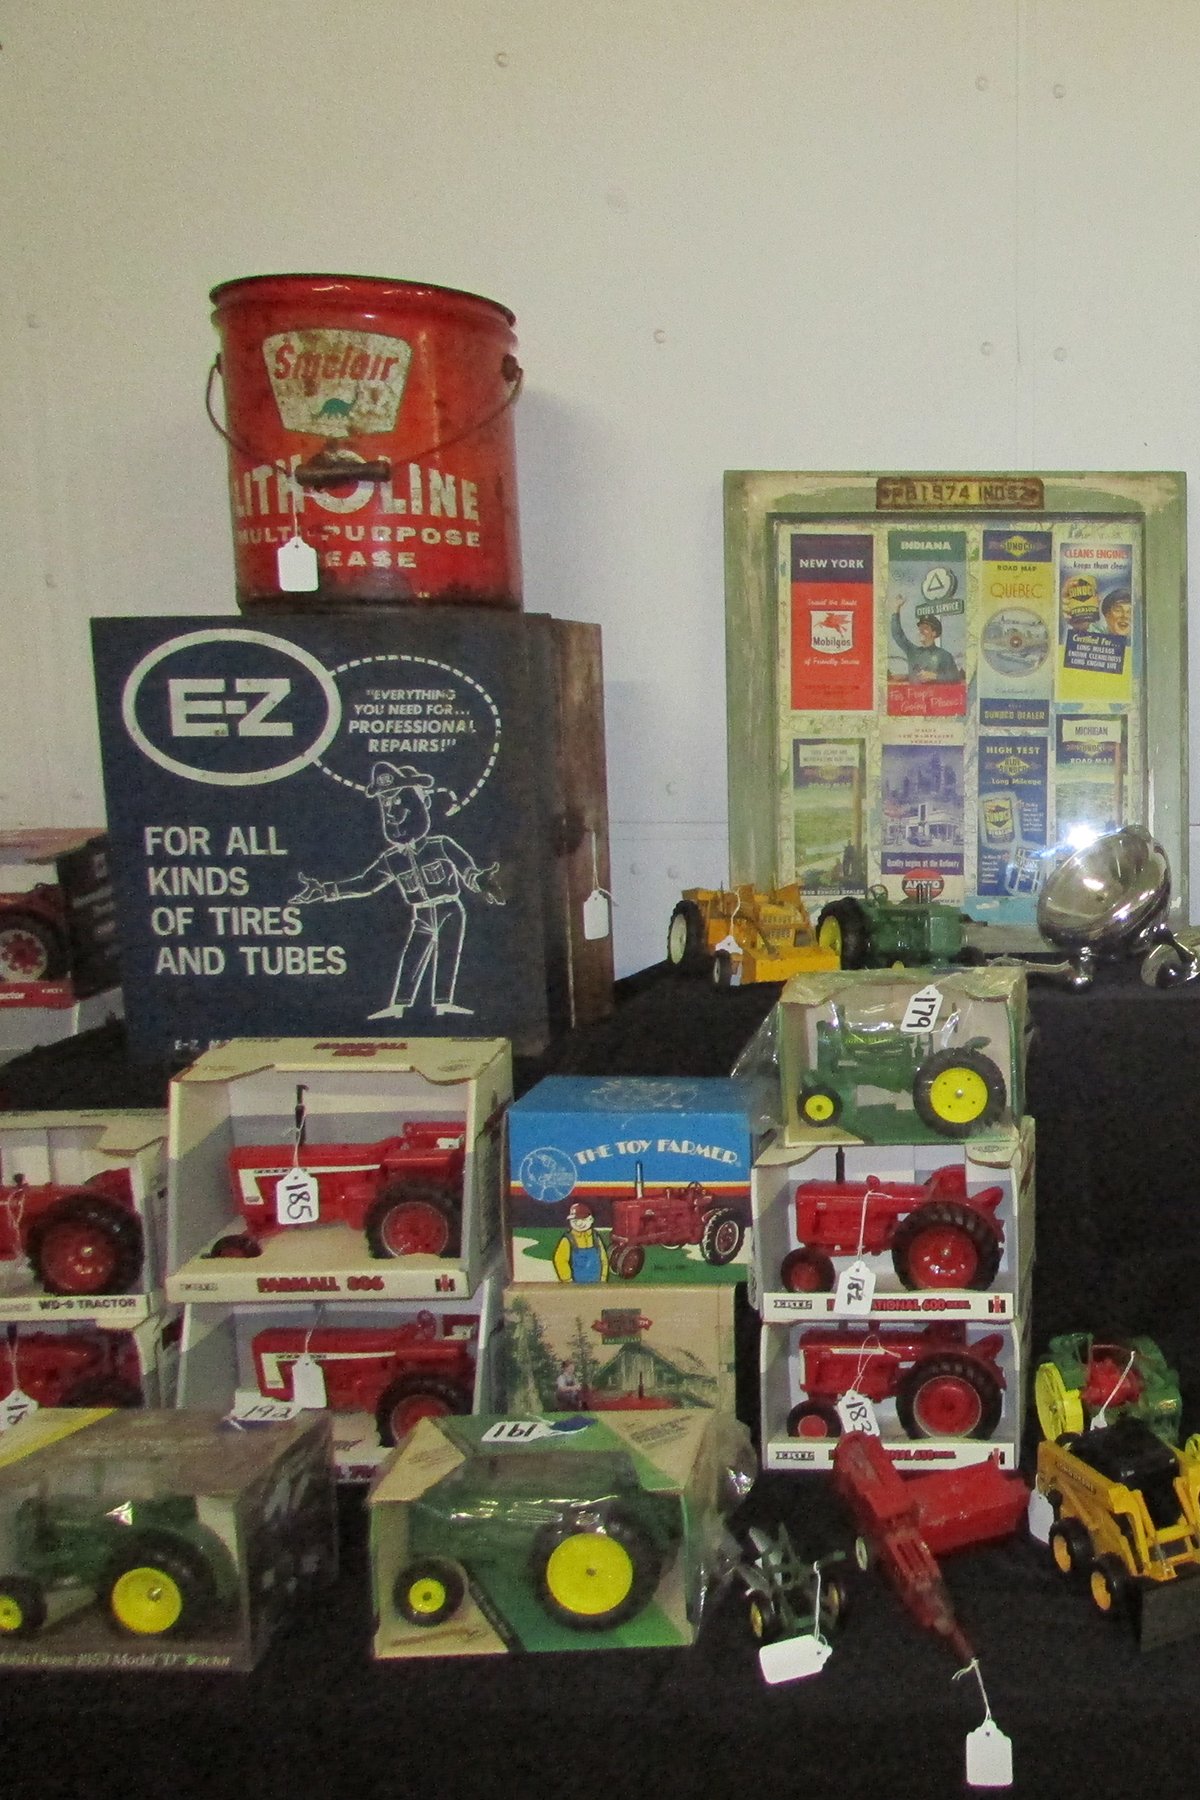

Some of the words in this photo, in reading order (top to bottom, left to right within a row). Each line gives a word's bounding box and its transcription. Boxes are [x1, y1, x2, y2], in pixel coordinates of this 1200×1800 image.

[272, 343, 399, 382] Sinclair
[901, 541, 952, 550] INDIANA
[325, 550, 417, 568] EASE
[1064, 549, 1094, 558] CLEANS
[800, 559, 827, 568] NEW
[831, 559, 864, 568] YORK
[990, 582, 1043, 599] QUEBEC
[917, 606, 935, 616] CITIES
[936, 601, 959, 613] SERVICE
[813, 637, 850, 648] Mobilgas
[169, 678, 293, 737] E-Z
[354, 704, 385, 716] YOU
[388, 704, 424, 716] NEED
[985, 711, 1014, 719] SUNOCO
[1017, 711, 1045, 720] DEALER
[348, 720, 477, 734] PROFESSIONAL
[1075, 727, 1109, 736] MICHIGAN
[987, 746, 1013, 754] HIGH
[1017, 746, 1041, 755] TEST
[1012, 778, 1042, 786] Mileage
[145, 826, 211, 856] FOR
[226, 826, 289, 856] ALL
[148, 867, 250, 896] KINDS
[905, 880, 942, 889] AMO
[152, 907, 200, 936] OF
[214, 906, 303, 936] TIRES
[155, 947, 226, 976] AND
[240, 946, 347, 975] TUBES
[906, 997, 937, 1029] 179
[575, 1145, 614, 1165] THE
[615, 1139, 652, 1155] TOY
[657, 1139, 738, 1165] FARMER
[285, 1182, 313, 1220] 185
[77, 1298, 136, 1309] TRACTOR
